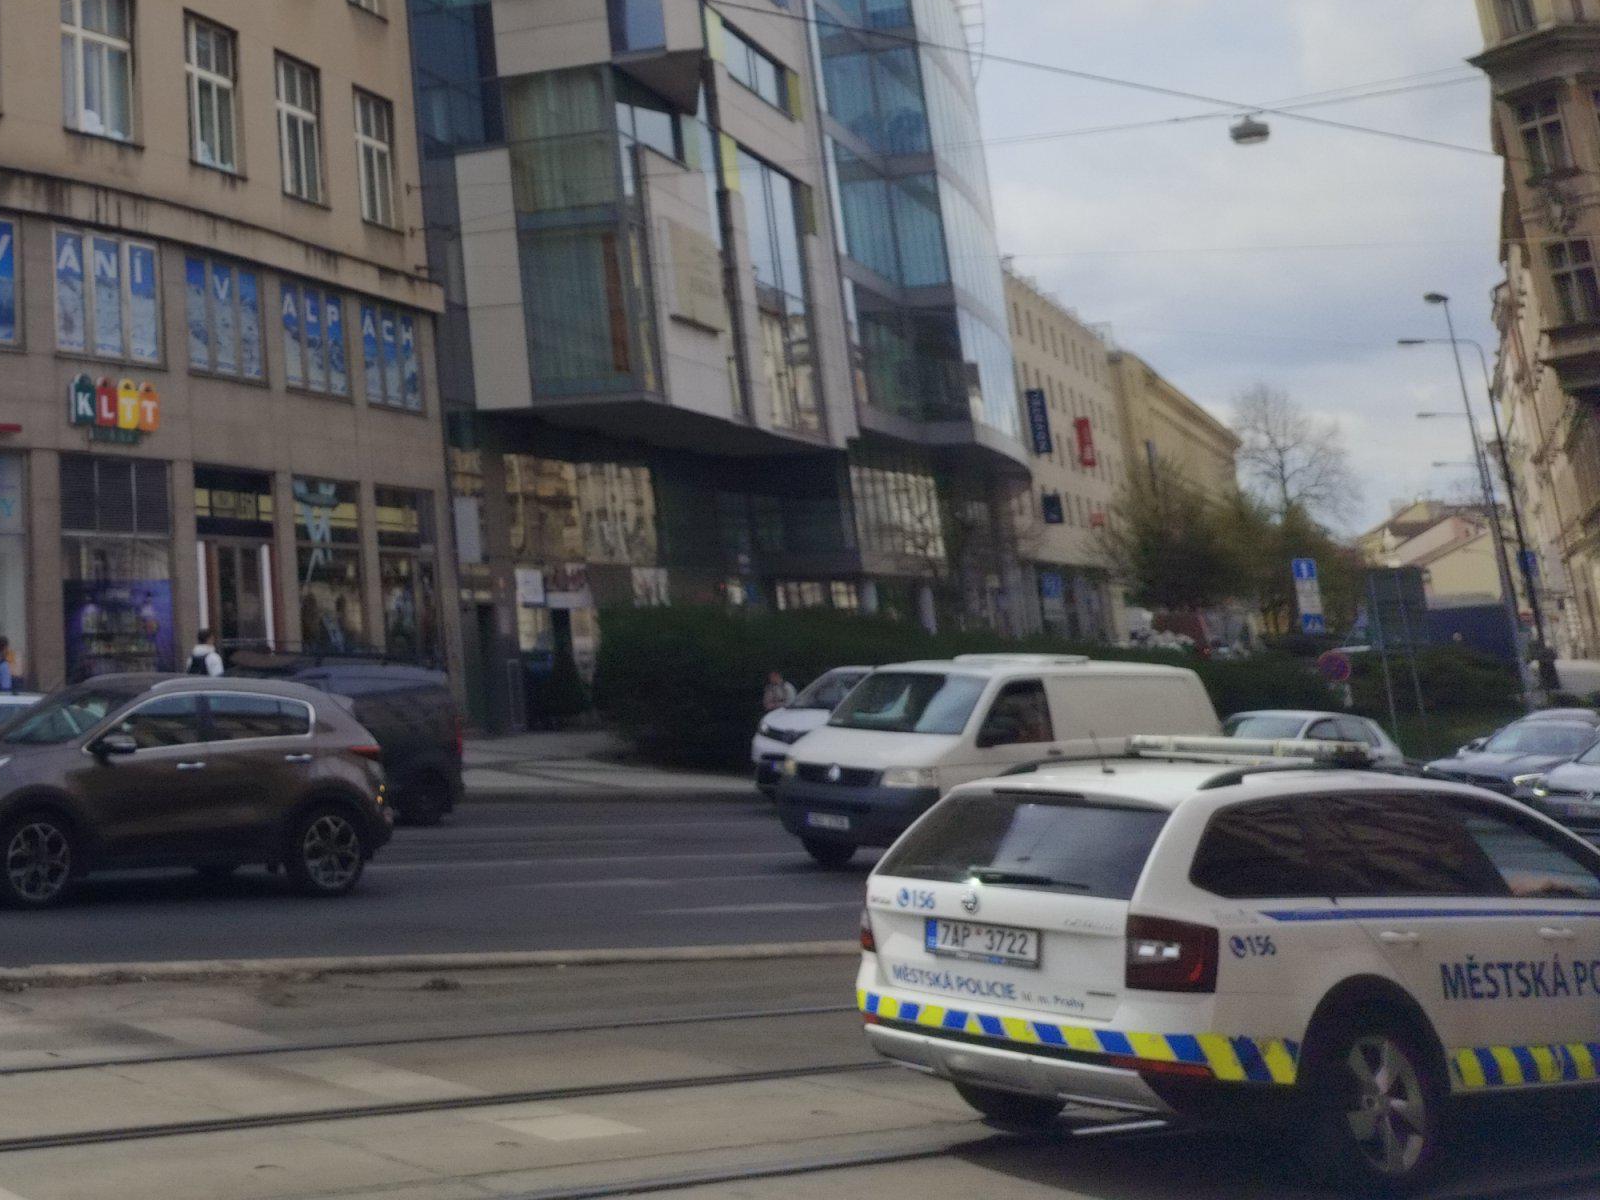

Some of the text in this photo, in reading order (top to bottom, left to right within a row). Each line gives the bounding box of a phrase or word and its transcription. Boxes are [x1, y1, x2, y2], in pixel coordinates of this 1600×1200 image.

[912, 889, 936, 909] 156
[941, 923, 1029, 955] 7AP 3722
[1246, 936, 1276, 956] 156
[892, 963, 953, 991] MĚSTSKÁ
[956, 974, 1017, 1001] POLICIE
[1439, 953, 1570, 1000] MĚSTSKÁ
